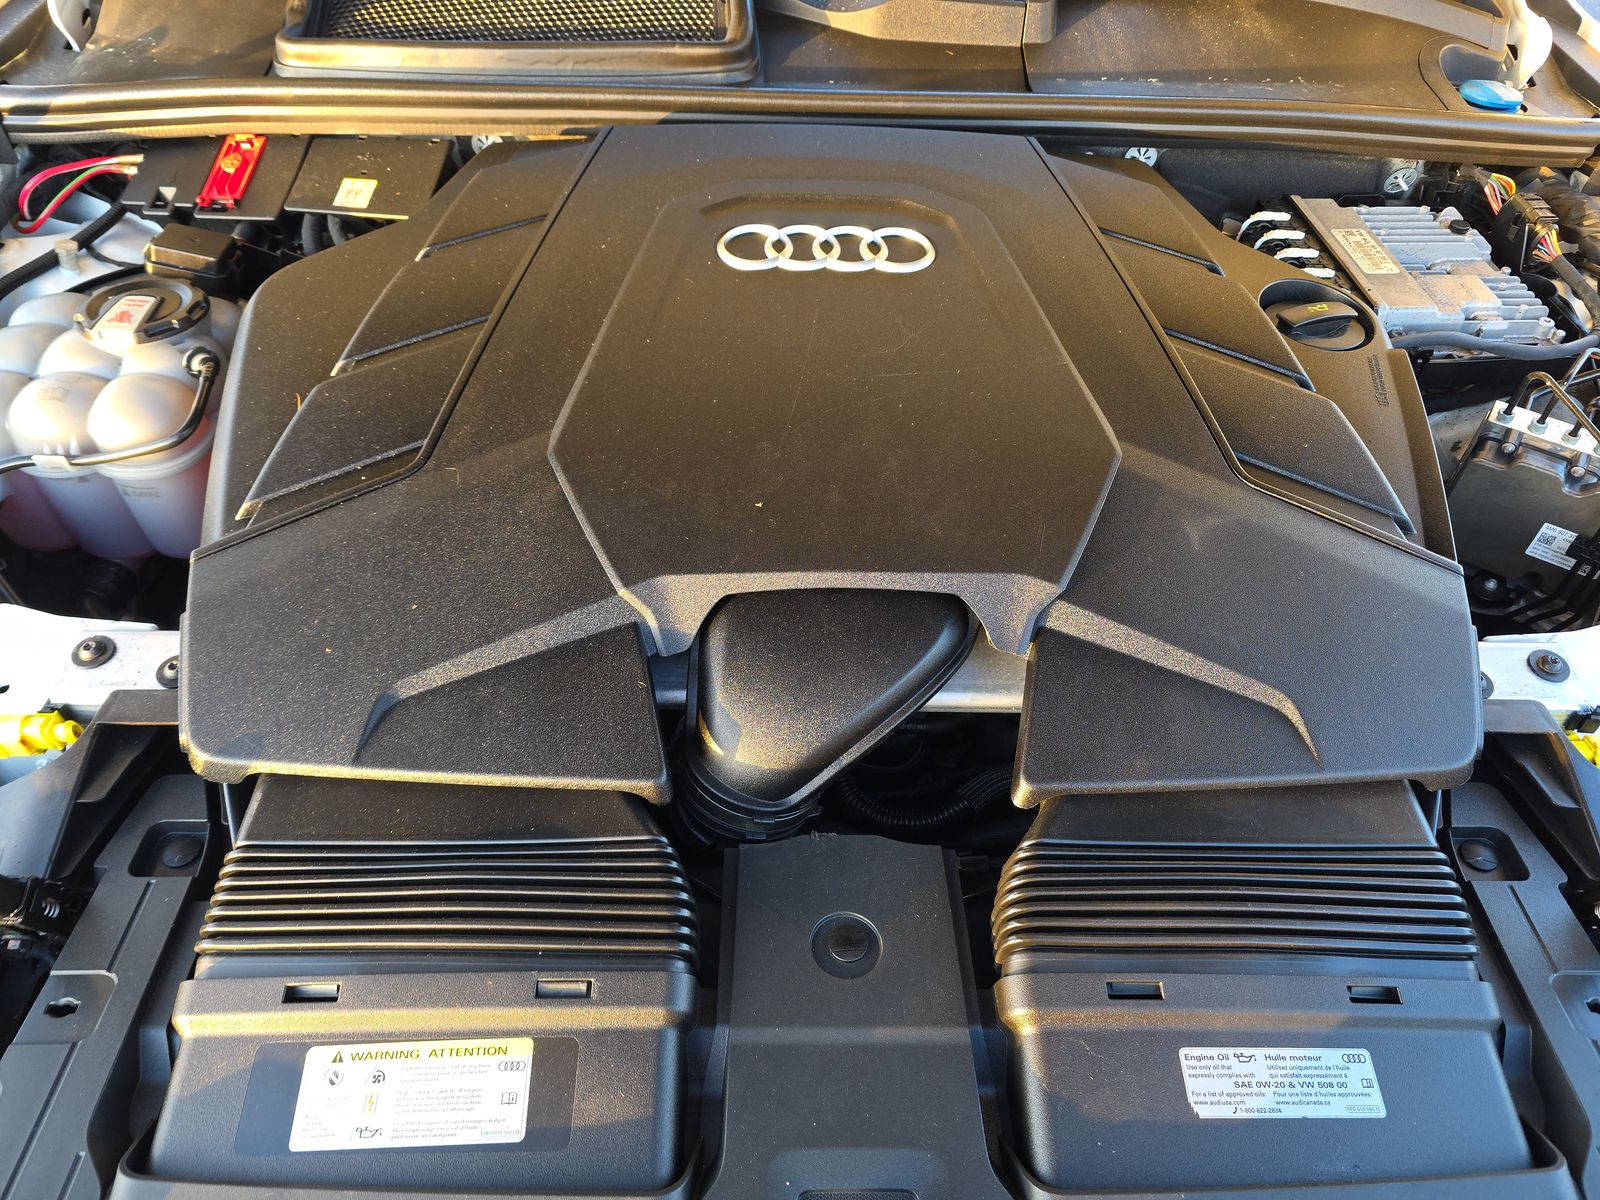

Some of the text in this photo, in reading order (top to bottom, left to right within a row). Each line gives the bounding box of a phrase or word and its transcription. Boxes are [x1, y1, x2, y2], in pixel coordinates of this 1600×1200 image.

[350, 1046, 509, 1062] WARNING ATTENTION
[1184, 1053, 1230, 1062] Engine Oil
[1264, 1053, 1287, 1061] Huile
[1198, 1064, 1211, 1072] only
[1288, 1064, 1323, 1072] uniquement
[1233, 1081, 1348, 1089] SAE 0W-20 & VW 508 00
[1226, 1091, 1254, 1099] approved
